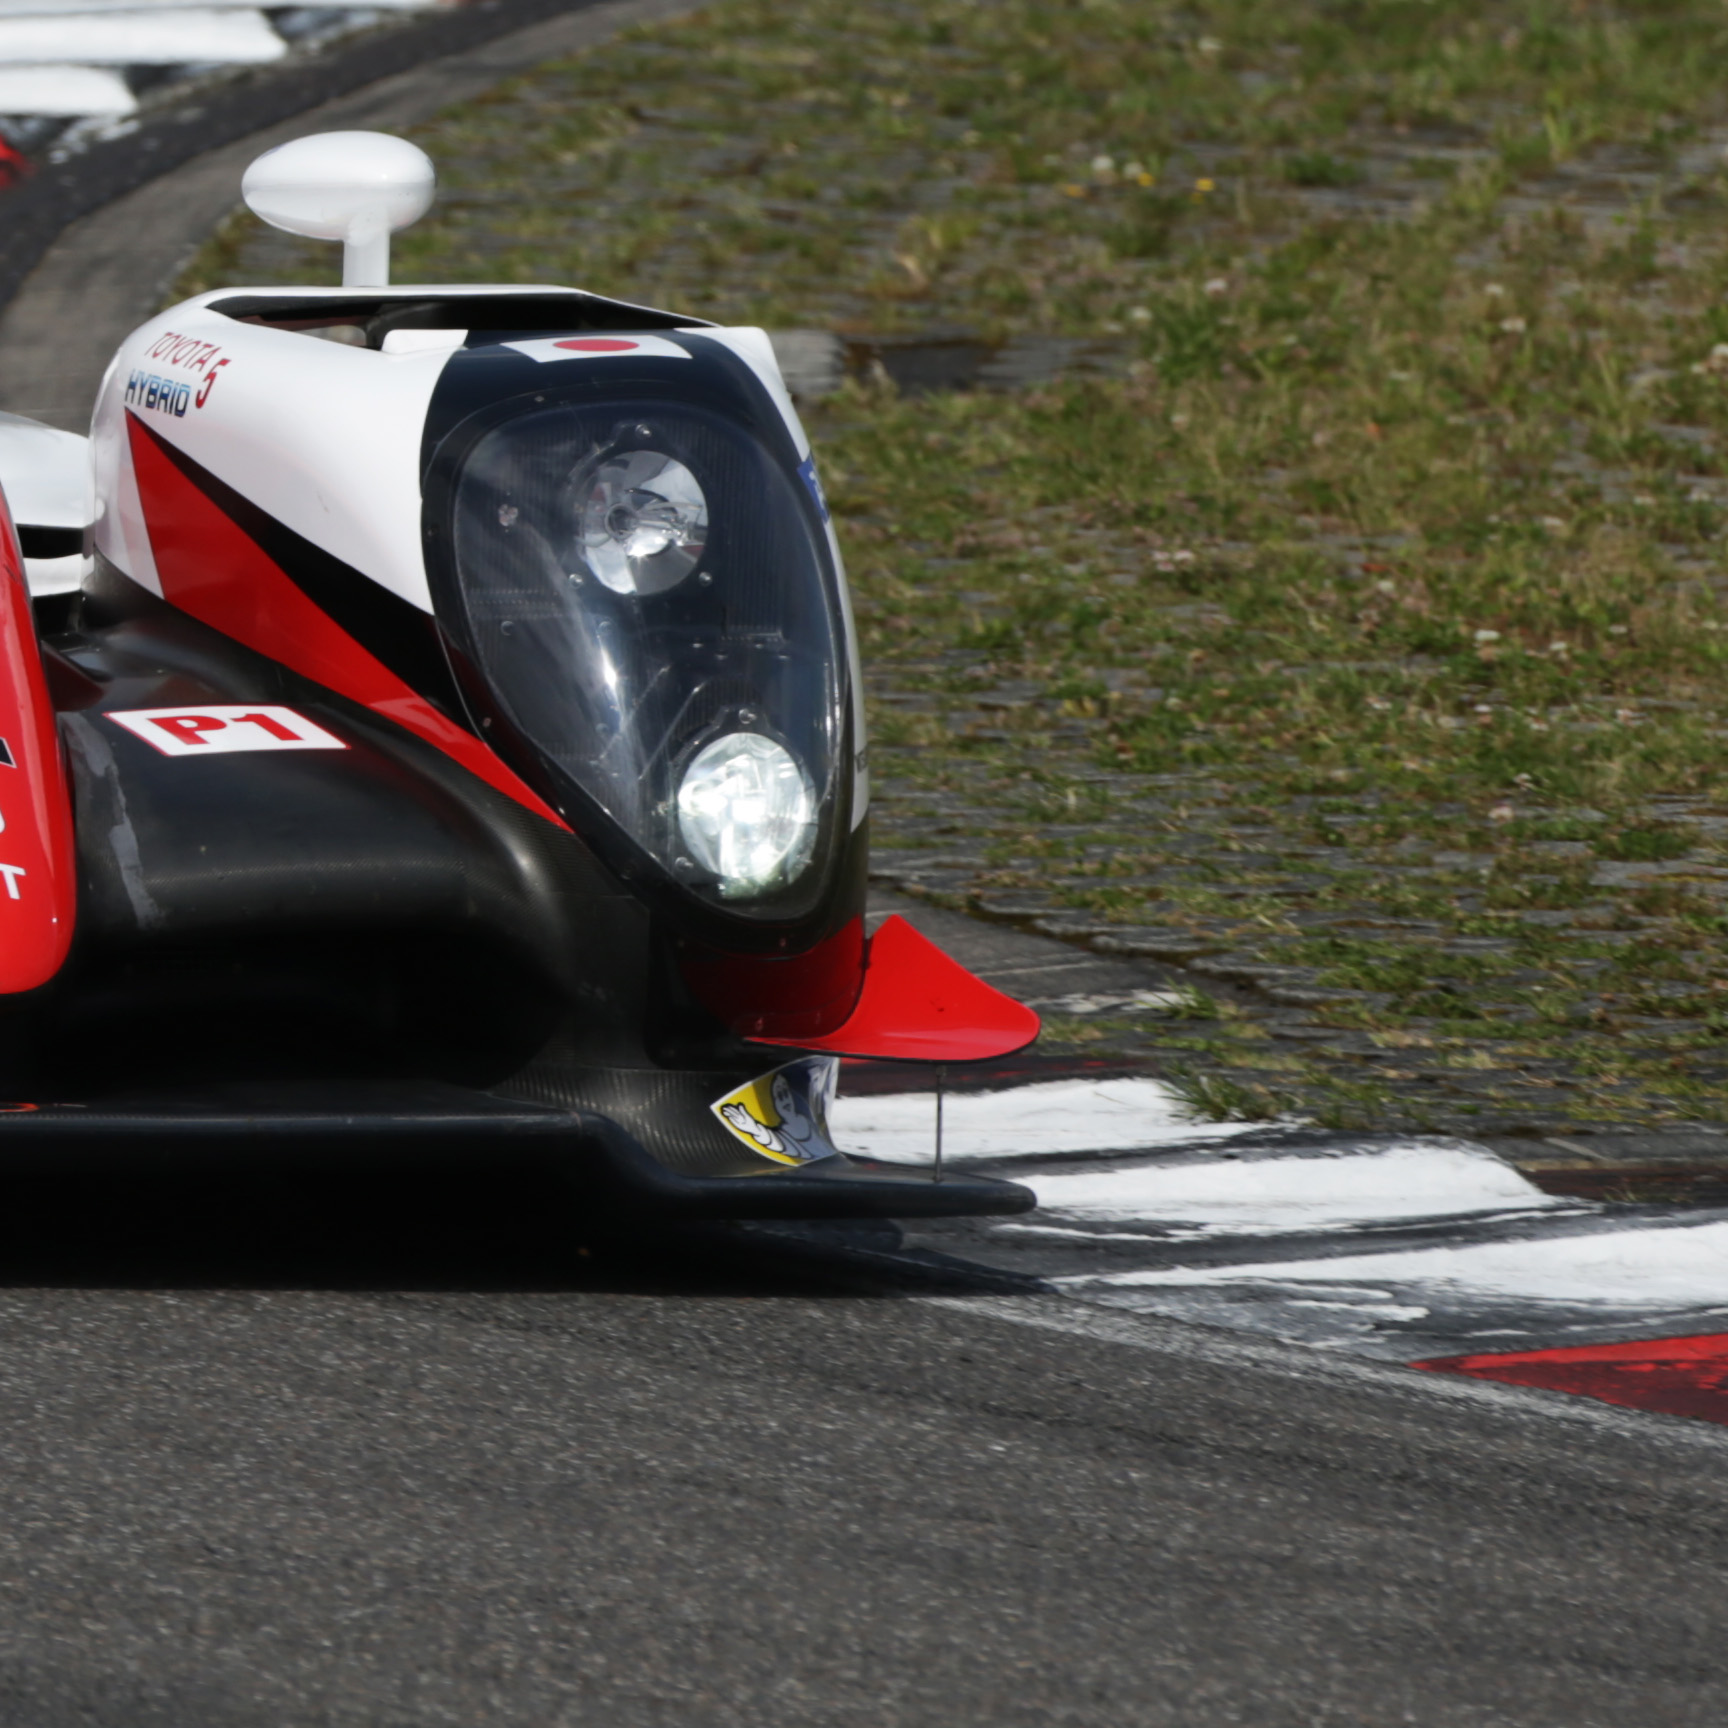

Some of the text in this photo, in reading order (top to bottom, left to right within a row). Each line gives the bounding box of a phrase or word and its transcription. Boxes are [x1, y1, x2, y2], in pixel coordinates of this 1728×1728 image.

[125, 368, 191, 418] HYBRID
[144, 332, 232, 409] TOYOTA 5
[147, 713, 304, 746] P1
